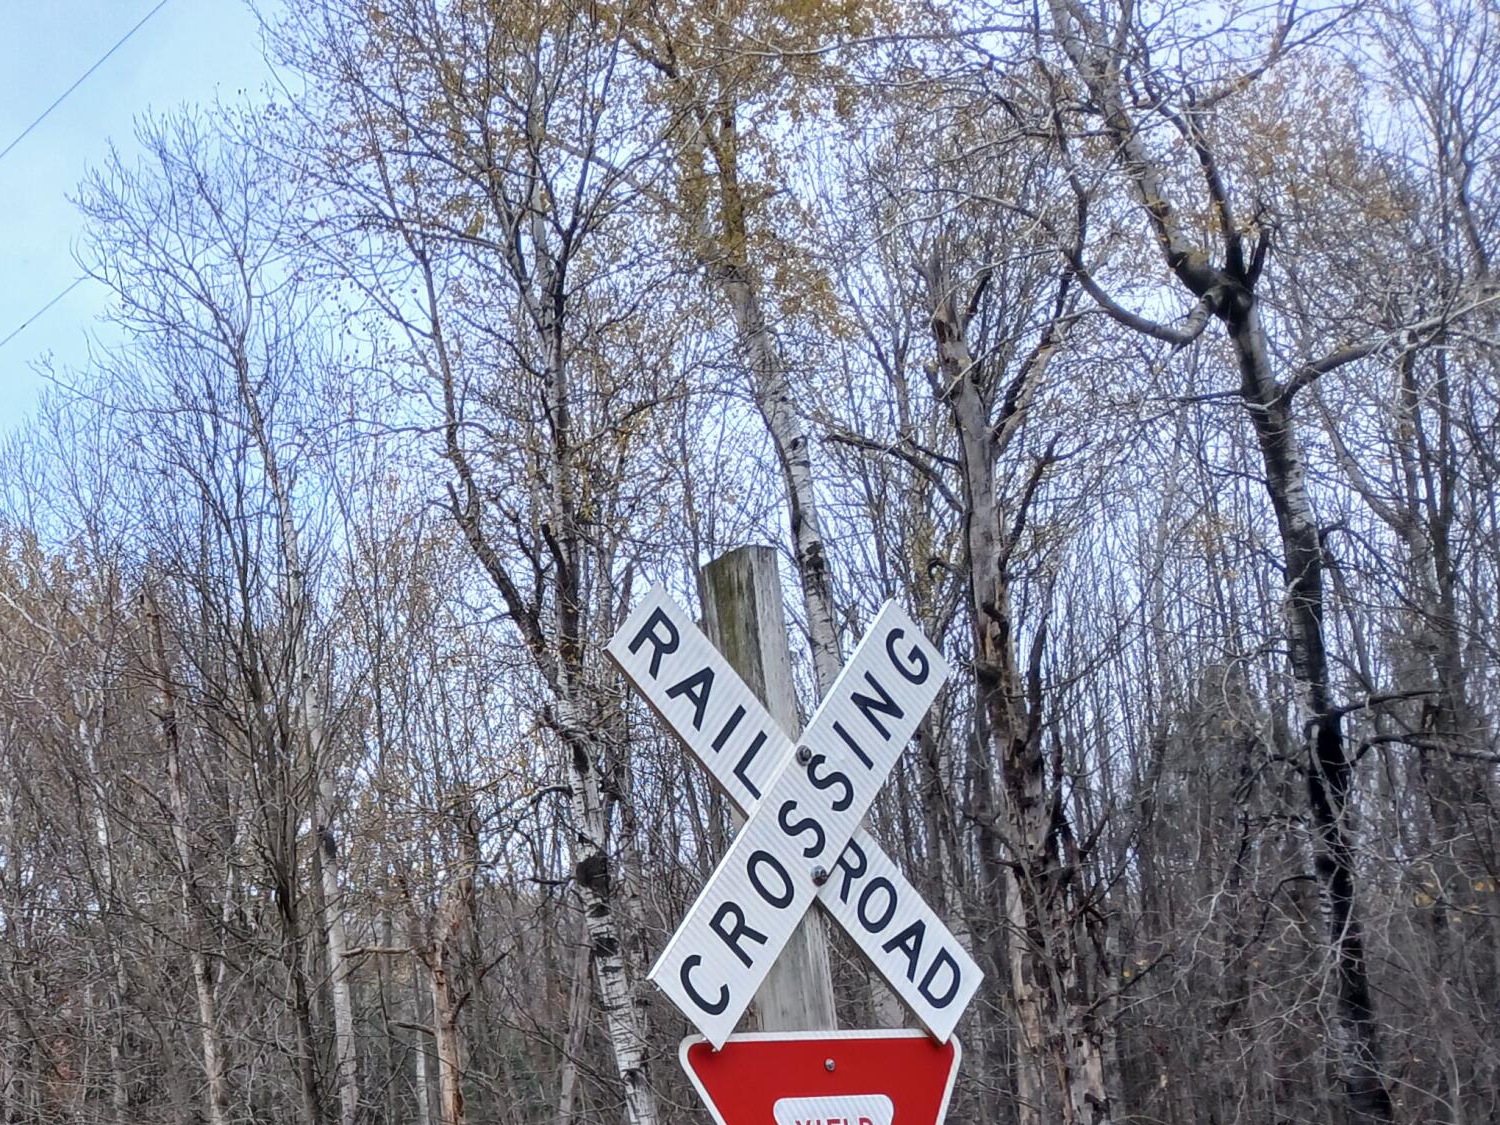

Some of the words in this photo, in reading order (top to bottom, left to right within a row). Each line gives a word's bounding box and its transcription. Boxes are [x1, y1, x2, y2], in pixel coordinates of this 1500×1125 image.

[628, 606, 767, 800] RAIL
[836, 839, 961, 1010] ROAD
[680, 627, 930, 1015] CROSSING
